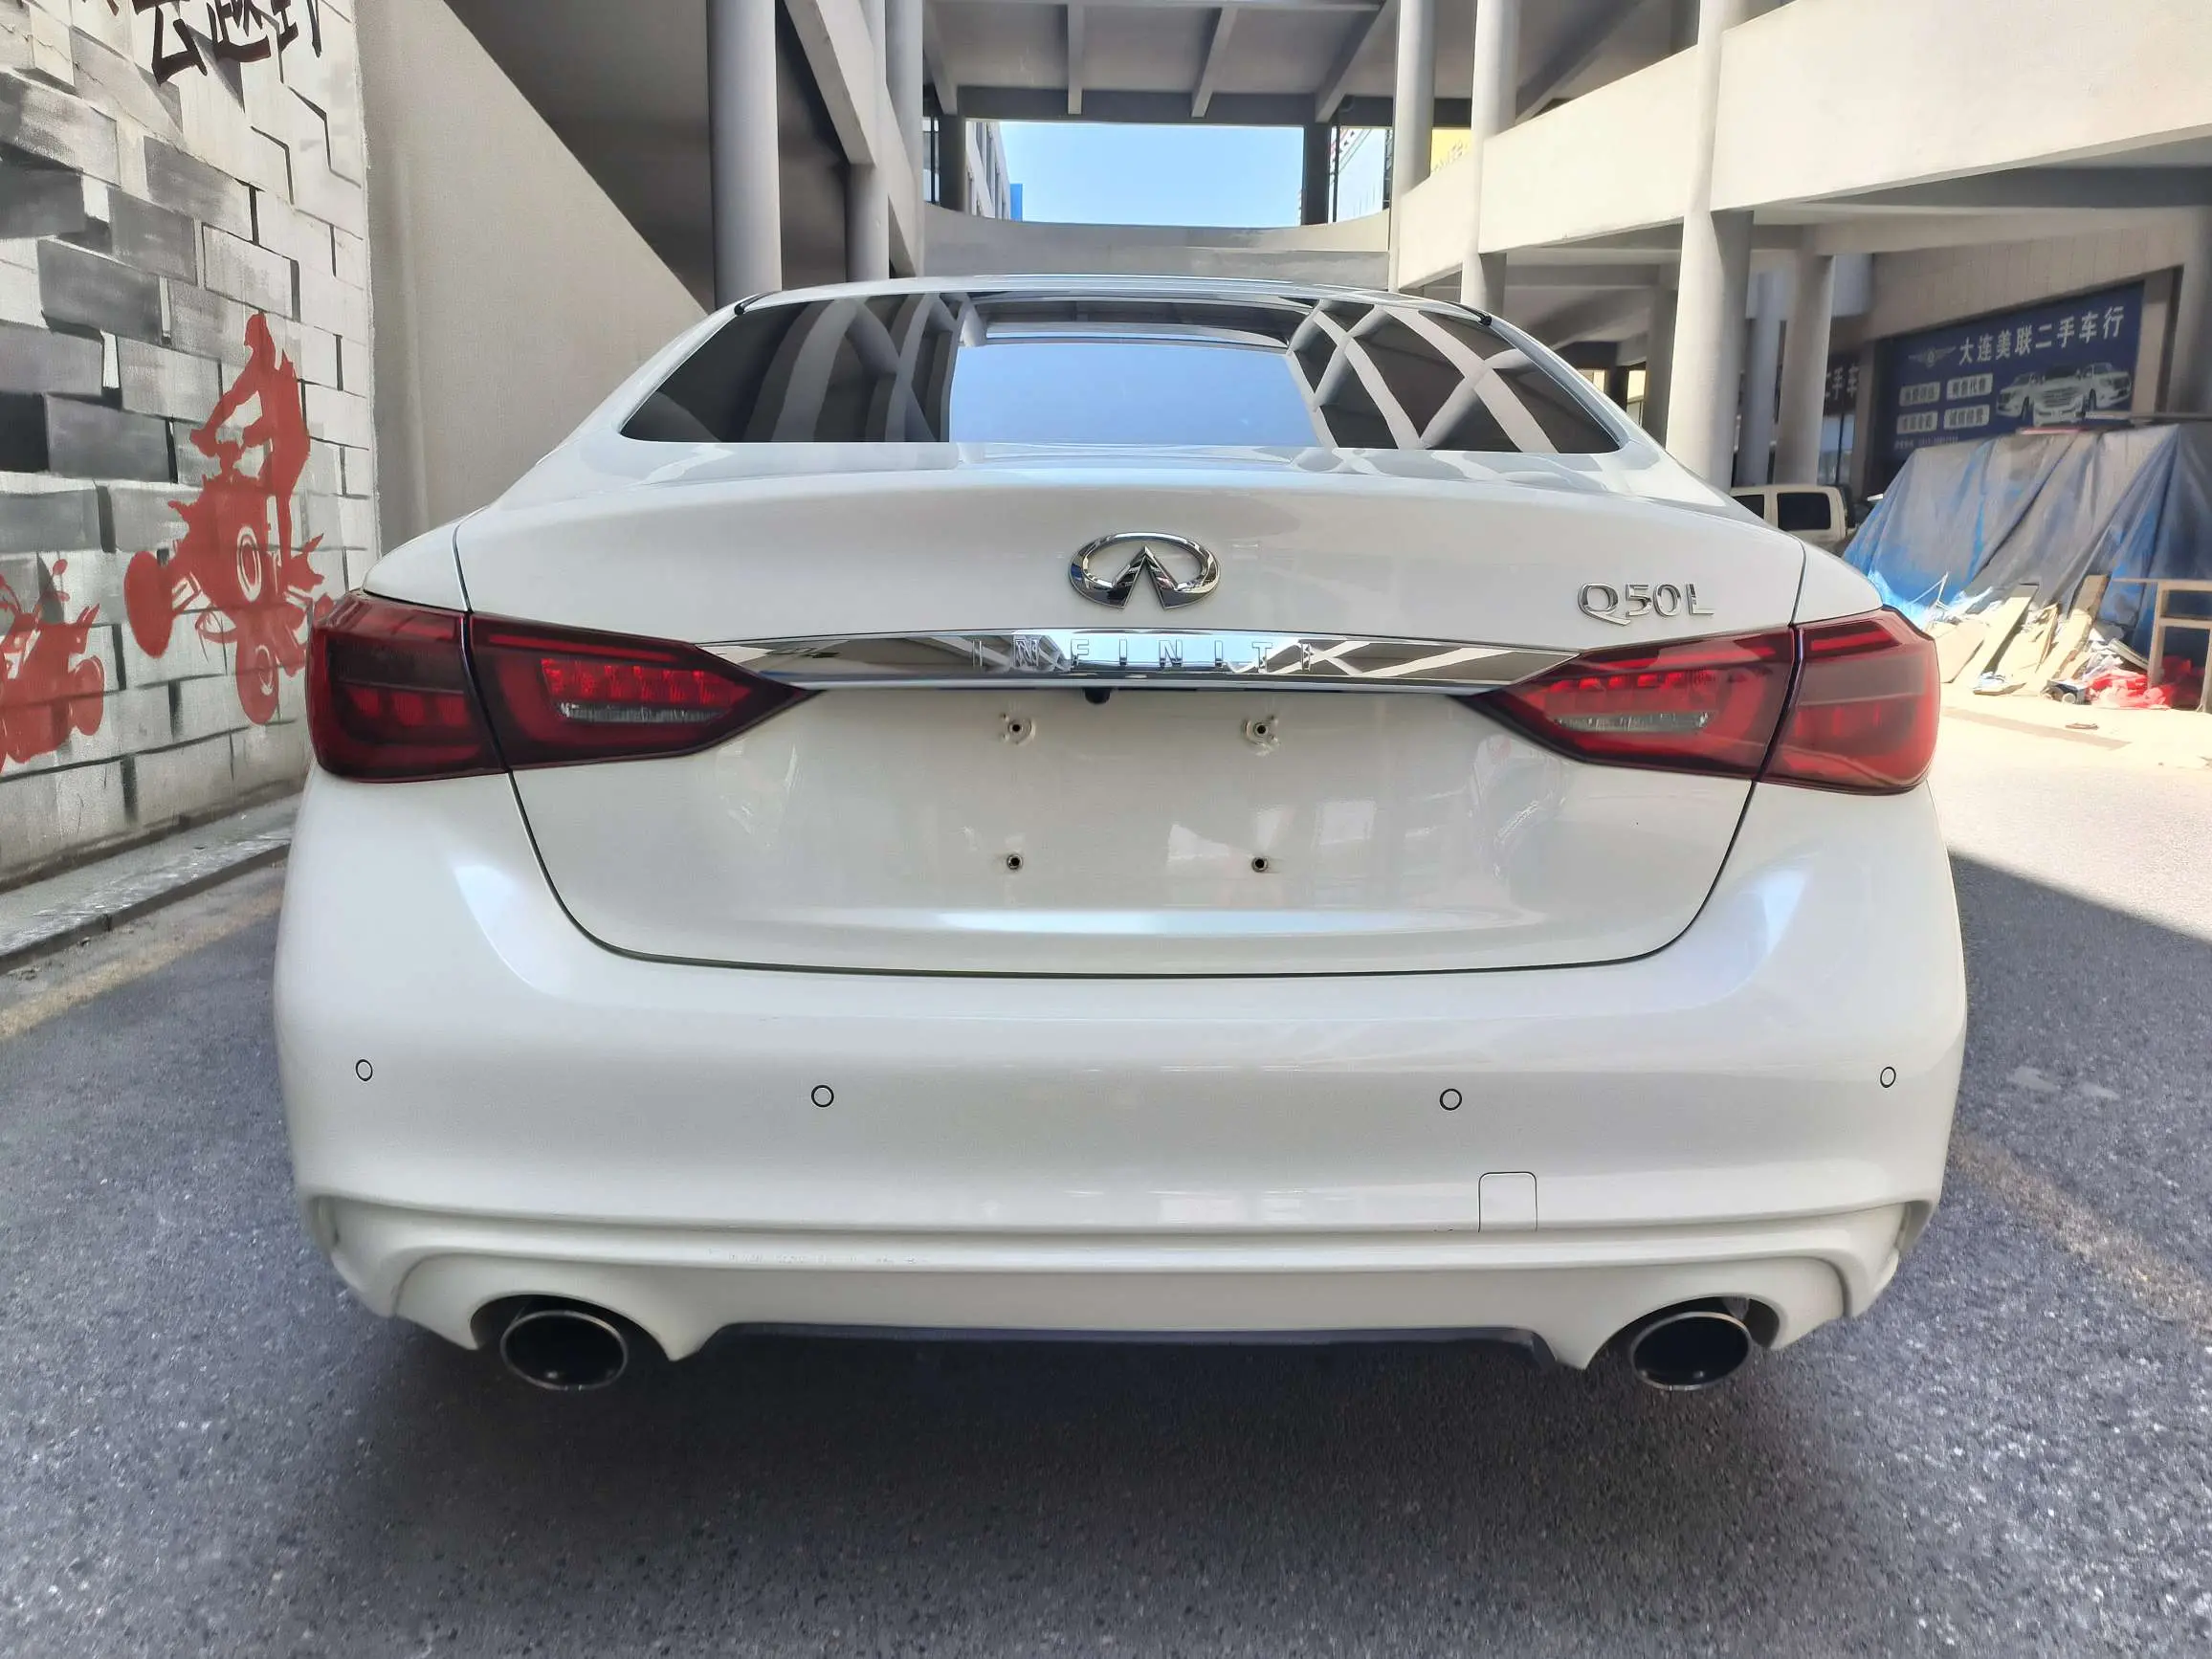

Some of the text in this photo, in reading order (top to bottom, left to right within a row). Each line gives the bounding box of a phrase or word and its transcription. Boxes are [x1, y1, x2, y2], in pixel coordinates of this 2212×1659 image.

[1958, 305, 2124, 365] 大连美联二手车行
[1578, 582, 1714, 626] Q50L
[971, 636, 1313, 674] INFINITI
